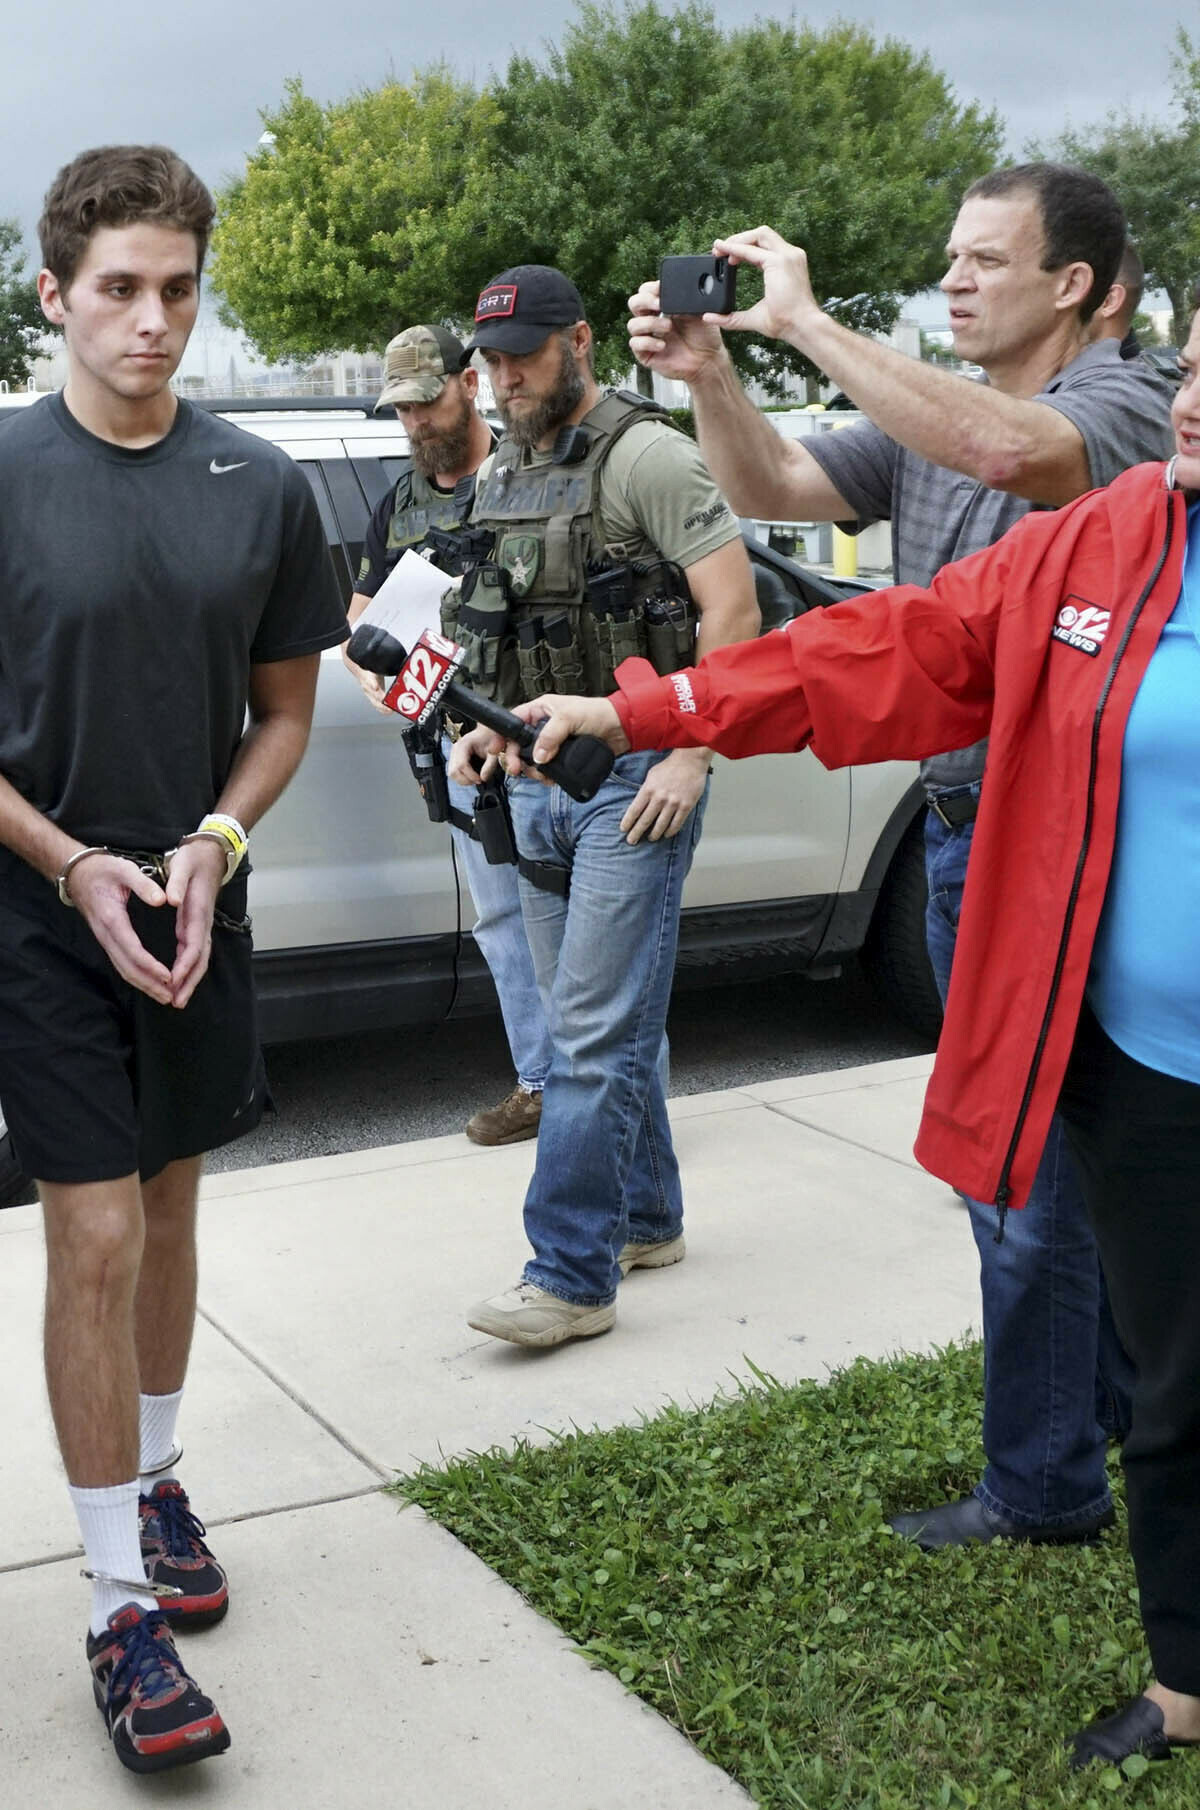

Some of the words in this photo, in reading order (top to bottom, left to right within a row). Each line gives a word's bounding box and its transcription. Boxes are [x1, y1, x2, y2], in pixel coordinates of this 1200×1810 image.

[1053, 625, 1097, 652] NEWS
[1070, 606, 1110, 642] 12
[402, 648, 442, 702] 12
